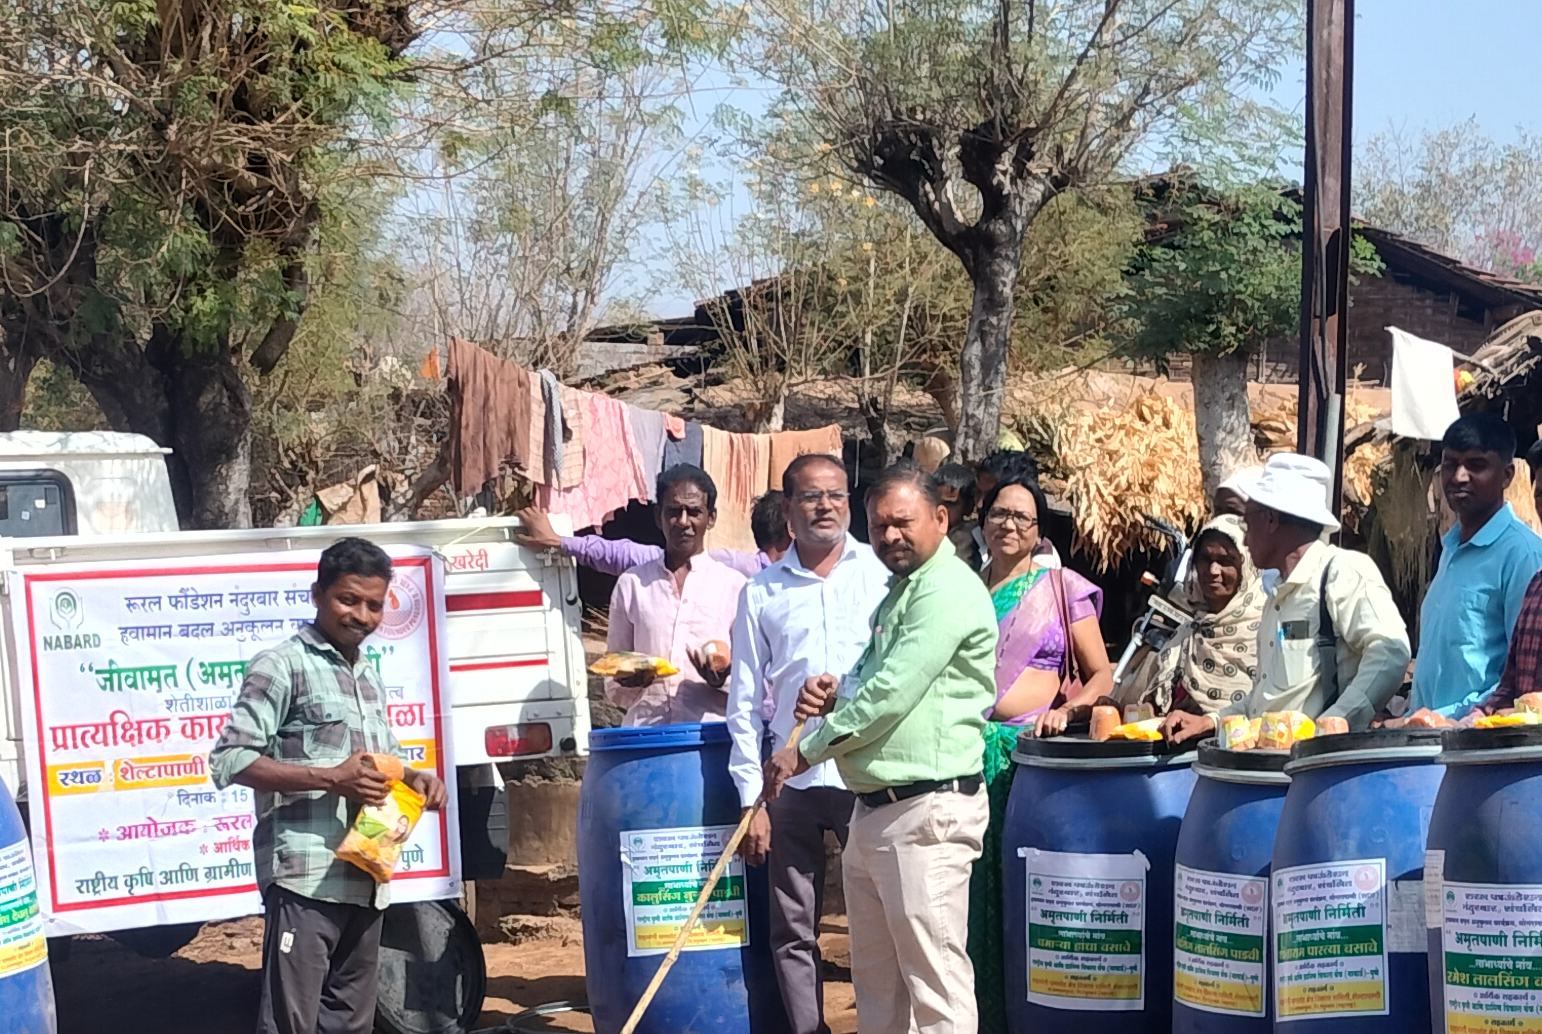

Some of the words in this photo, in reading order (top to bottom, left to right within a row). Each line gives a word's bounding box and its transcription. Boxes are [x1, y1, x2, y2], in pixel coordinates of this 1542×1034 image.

[125, 595, 162, 613] रूरल
[228, 585, 278, 616] नंदुरबार
[284, 583, 313, 605] संच
[43, 632, 102, 651] NABARD
[118, 624, 172, 646] हवामान
[177, 621, 214, 638] बदल
[221, 618, 284, 642] अनुकूलन
[49, 709, 171, 751] प्रात्यक्षिक
[59, 769, 102, 786] स्थळ
[120, 755, 205, 781] शेल्टापाणी
[177, 787, 216, 807] दिनांक
[116, 816, 196, 841] आयोजक
[213, 813, 252, 832] रूरल
[214, 835, 250, 854] आर्थिक
[75, 870, 119, 896] राष्ट्रीय
[124, 866, 154, 895] कृषि
[159, 861, 199, 886] आणि
[203, 857, 252, 883] ग्रामीण
[1454, 929, 1509, 952] अमृतपाणी
